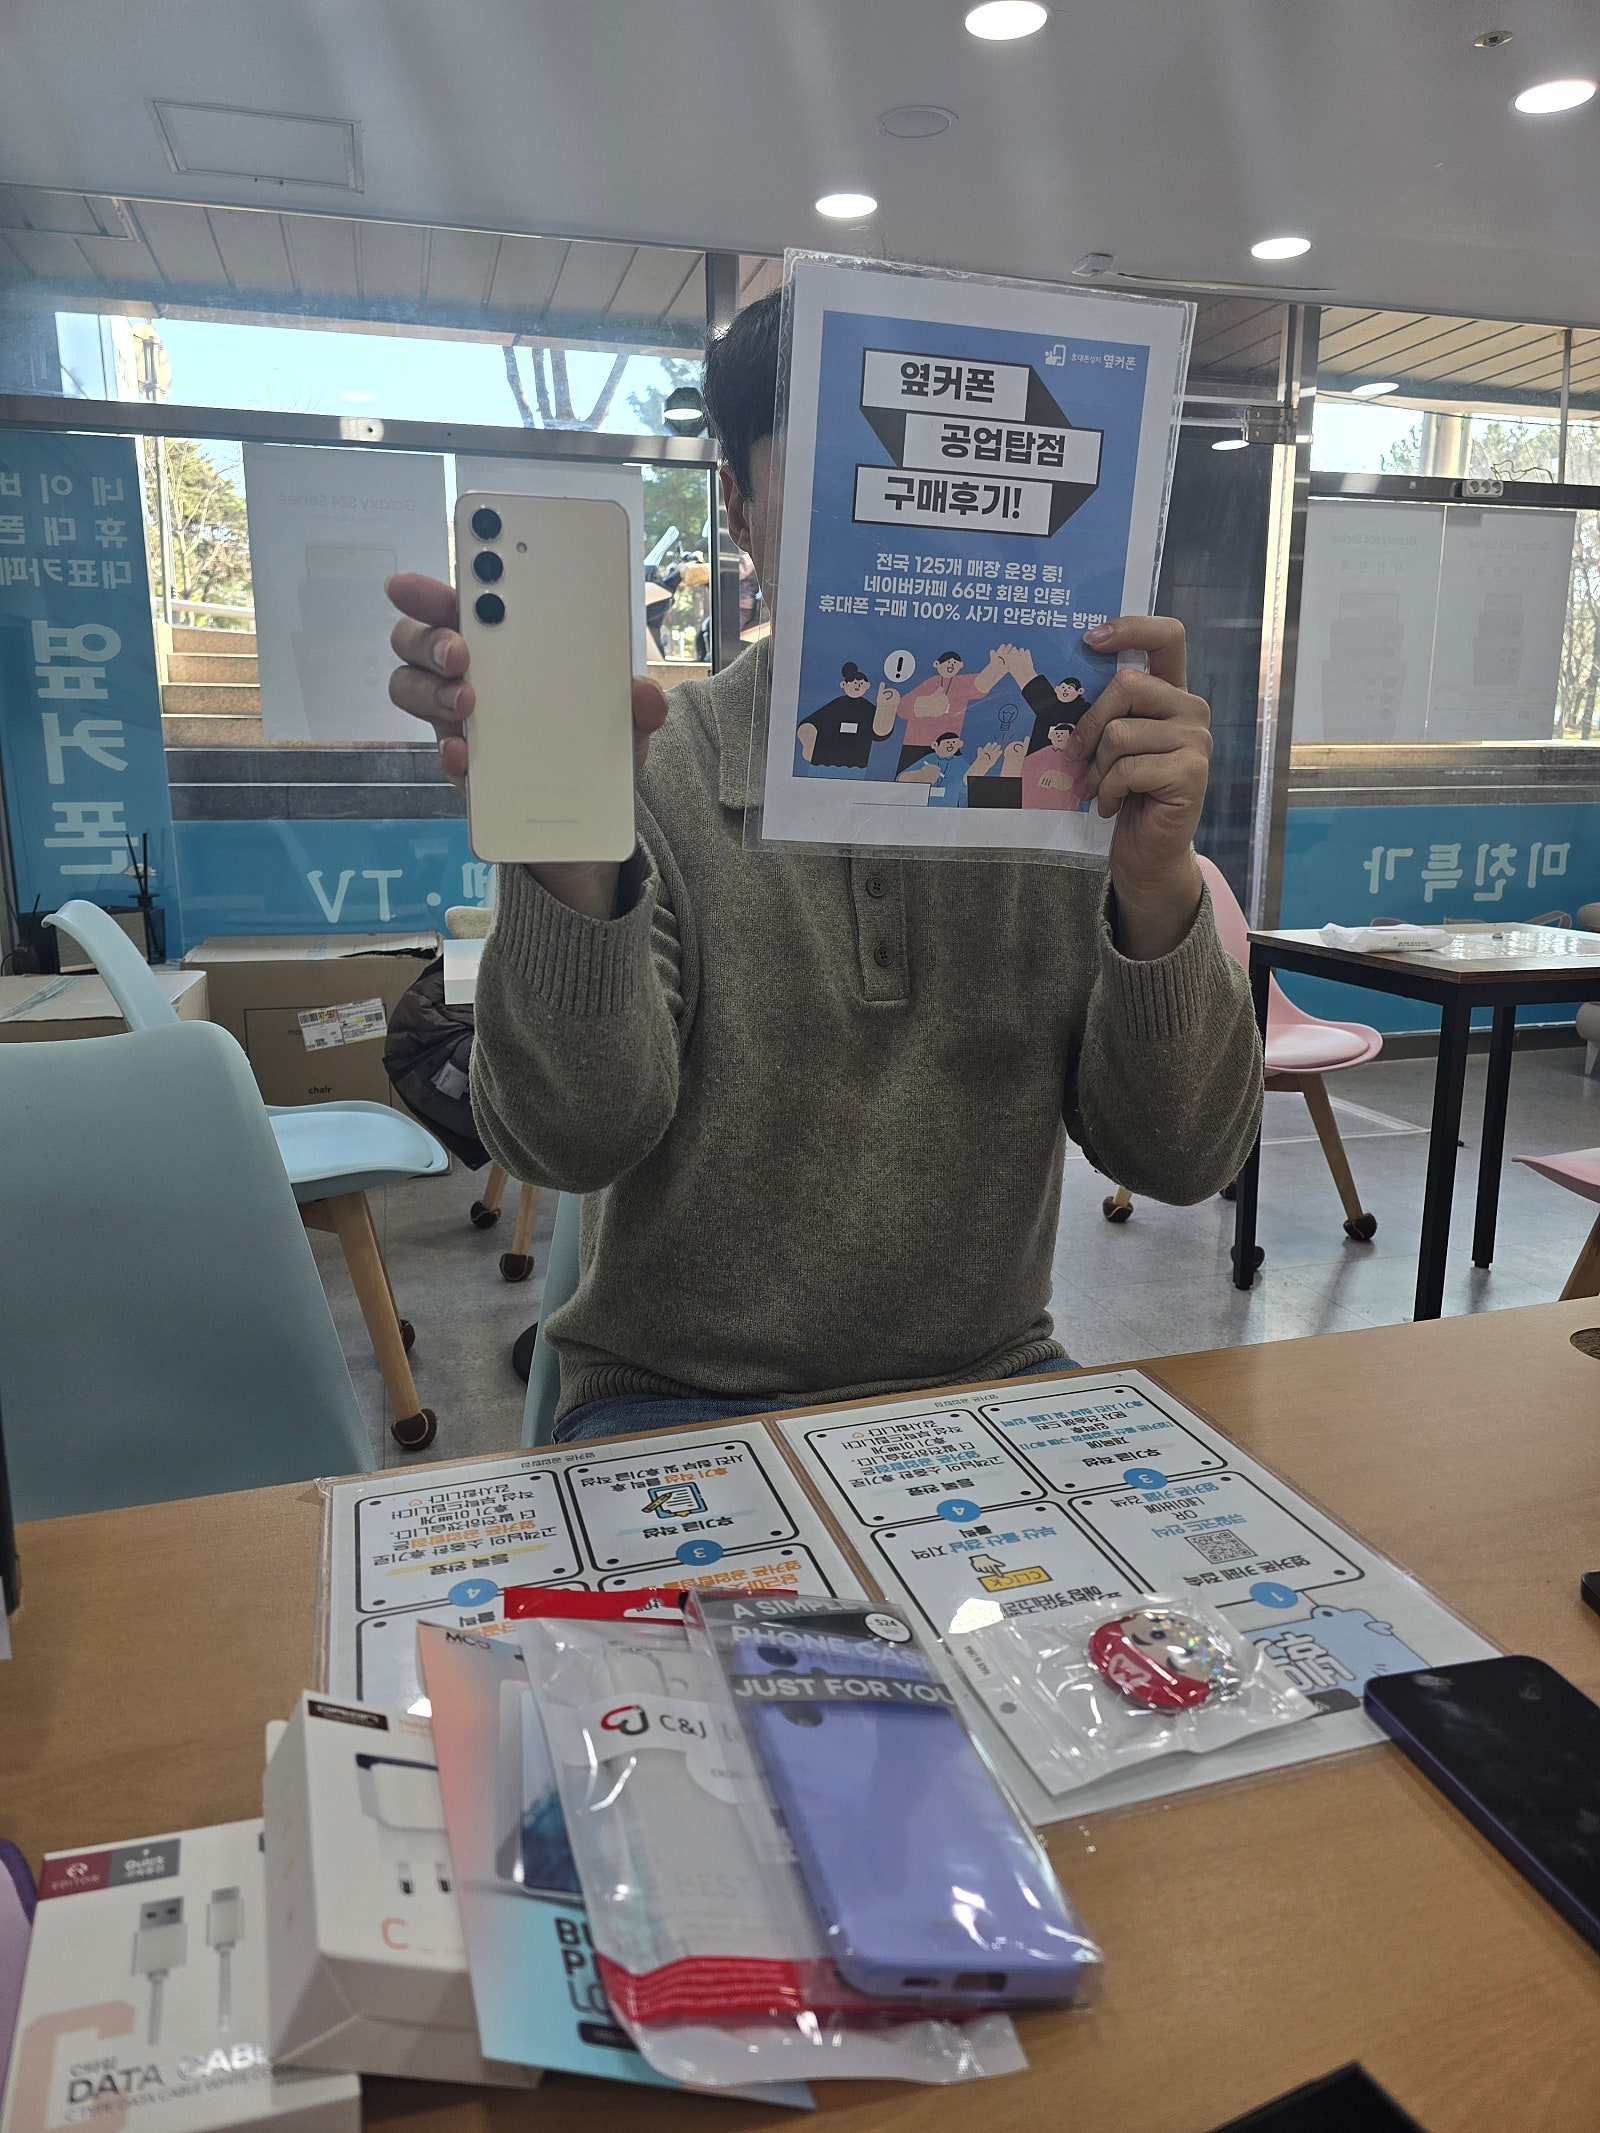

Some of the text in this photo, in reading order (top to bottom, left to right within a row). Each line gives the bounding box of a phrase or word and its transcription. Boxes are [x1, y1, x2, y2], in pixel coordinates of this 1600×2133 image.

[1103, 354, 1137, 371] 옆커폰
[900, 361, 995, 403] 옆커폰
[940, 423, 1066, 468] 공업탑점
[884, 476, 1023, 520] 구매후기!
[876, 553, 1063, 583] 전국 125개 매장 운영 중!
[863, 575, 1071, 606] 네이버카페 66만 회원 인증!
[818, 594, 869, 615] 휴대폰
[874, 599, 908, 618] 구매
[912, 601, 961, 622] 100%
[965, 605, 998, 624] 사기
[1003, 606, 1067, 628] 안당하는
[308, 1085, 332, 1095] chair
[868, 1420, 936, 1436] 감사합니다
[1034, 1420, 1062, 1431] 드린
[841, 1426, 963, 1450] 작성 부탁드립니다!
[870, 1436, 945, 1454] 후기 이쁘게
[960, 1441, 976, 1450] 더
[1085, 1436, 1130, 1449] 제목에
[1081, 1448, 1162, 1468] 후기글 작성
[580, 1454, 744, 1488] 사진 첨부 및 후기글 작성
[664, 1472, 696, 1484] 작성
[697, 1466, 729, 1479] 후기
[848, 1455, 1005, 1488] 고객님의 소중한 후기로
[1139, 1474, 1153, 1484] 3
[428, 1483, 510, 1504] 감사합니다
[610, 1483, 627, 1493] 후
[905, 1478, 975, 1497] 등록 완료
[1109, 1482, 1220, 1508] 옆커폰 카페 검색
[391, 1490, 534, 1520] 작성 부탁드립니다!
[420, 1504, 509, 1525] 후기 이쁘게
[519, 1509, 536, 1519] 더
[951, 1506, 966, 1516] 4
[1143, 1495, 1206, 1514] 네이버에
[1170, 1509, 1198, 1521] OR
[642, 1515, 735, 1540] 후기글 작성
[1150, 1513, 1247, 1538] 큐알코드 인식
[372, 1526, 558, 1566] 고객님의 소중한 후기로
[693, 1547, 705, 1559] 3
[910, 1526, 1057, 1560] 부산 울산 경남 지역
[428, 1554, 510, 1576] 등록 완료
[751, 1559, 803, 1579] 옆커폰
[1182, 1555, 1311, 1587] 옆커폰 카페 접속
[988, 1571, 1042, 1586] CLICK
[465, 1588, 481, 1599] 4
[732, 1603, 755, 1619] A
[730, 1626, 847, 1654] PHONE
[734, 1677, 818, 1698] JUST
[823, 1679, 892, 1699] FOR
[659, 1714, 707, 1739] C&J
[66, 2064, 165, 2105] DATA
[177, 2042, 269, 2081] CABL
